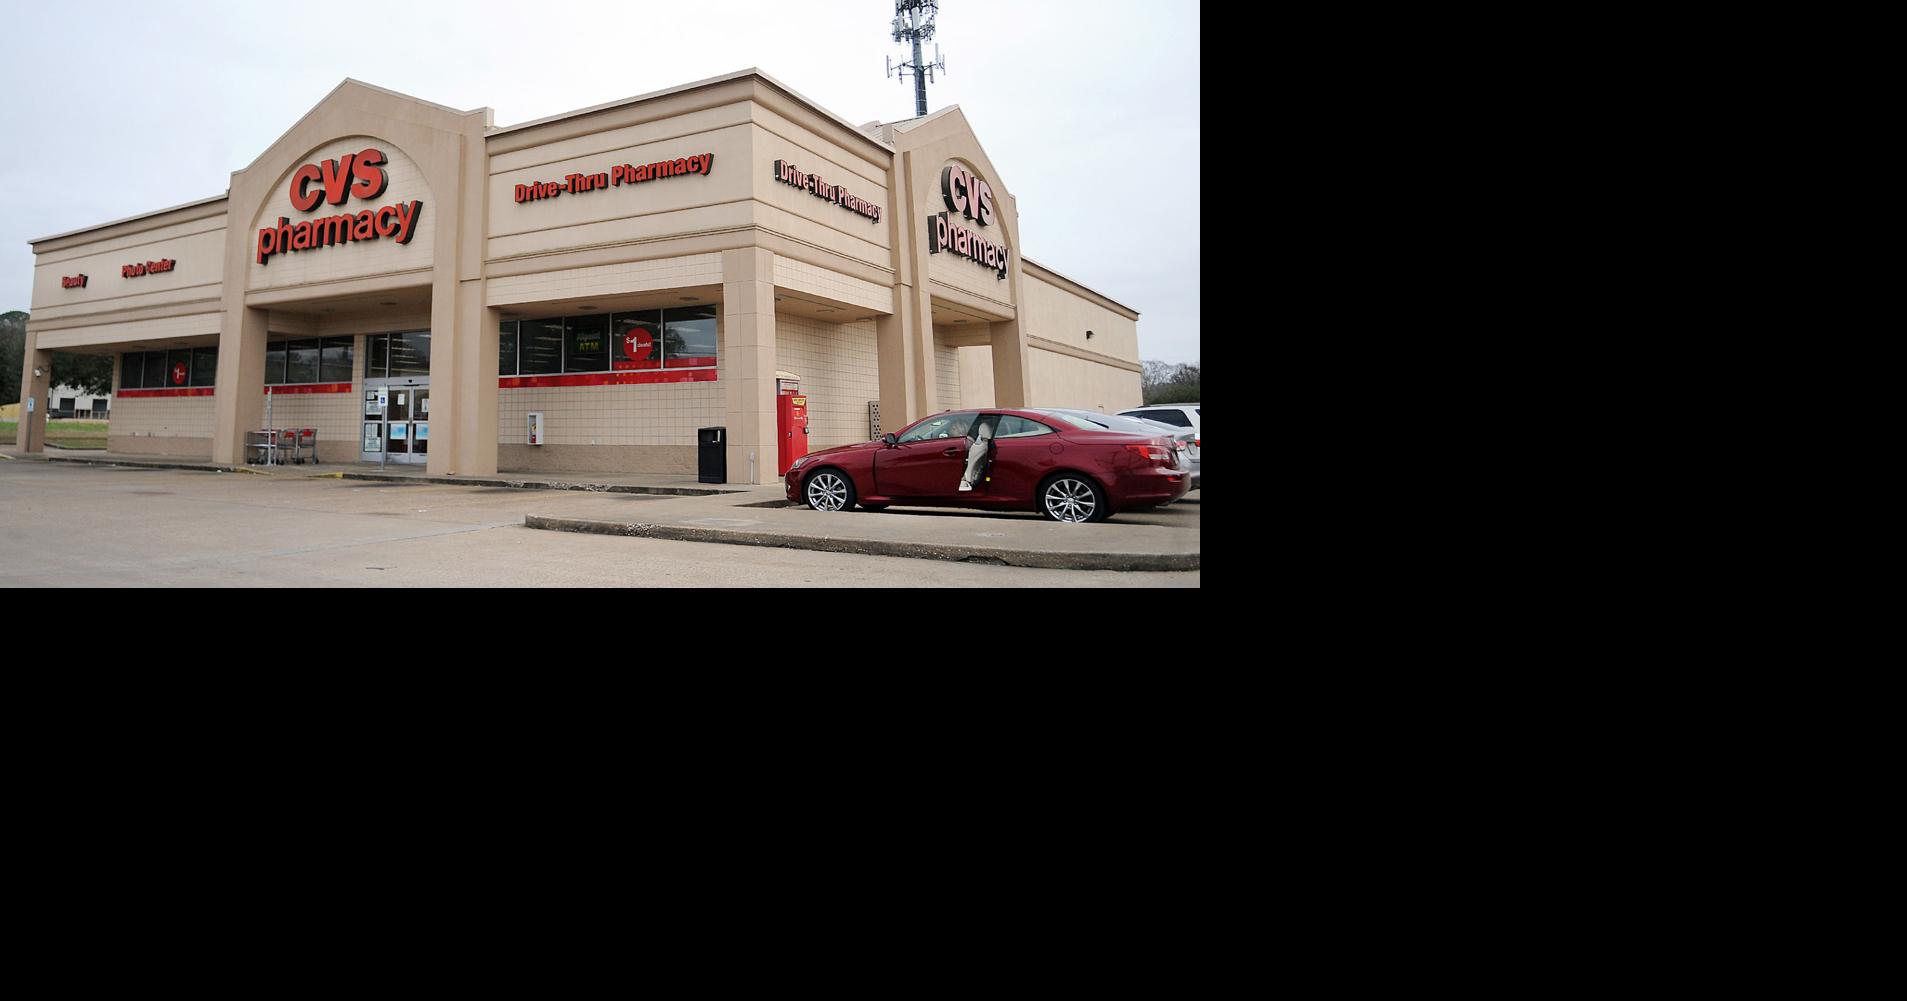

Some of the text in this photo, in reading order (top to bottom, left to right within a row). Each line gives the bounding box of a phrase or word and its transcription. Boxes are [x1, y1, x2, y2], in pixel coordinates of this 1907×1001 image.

[290, 148, 387, 212] CVS
[514, 152, 714, 203] Drive-Thru Pharmacy
[777, 160, 883, 223] Drive-Thru Pharmacy
[945, 164, 996, 226] CVS
[257, 200, 422, 265] pharmacy
[930, 211, 1010, 280] pharmacy
